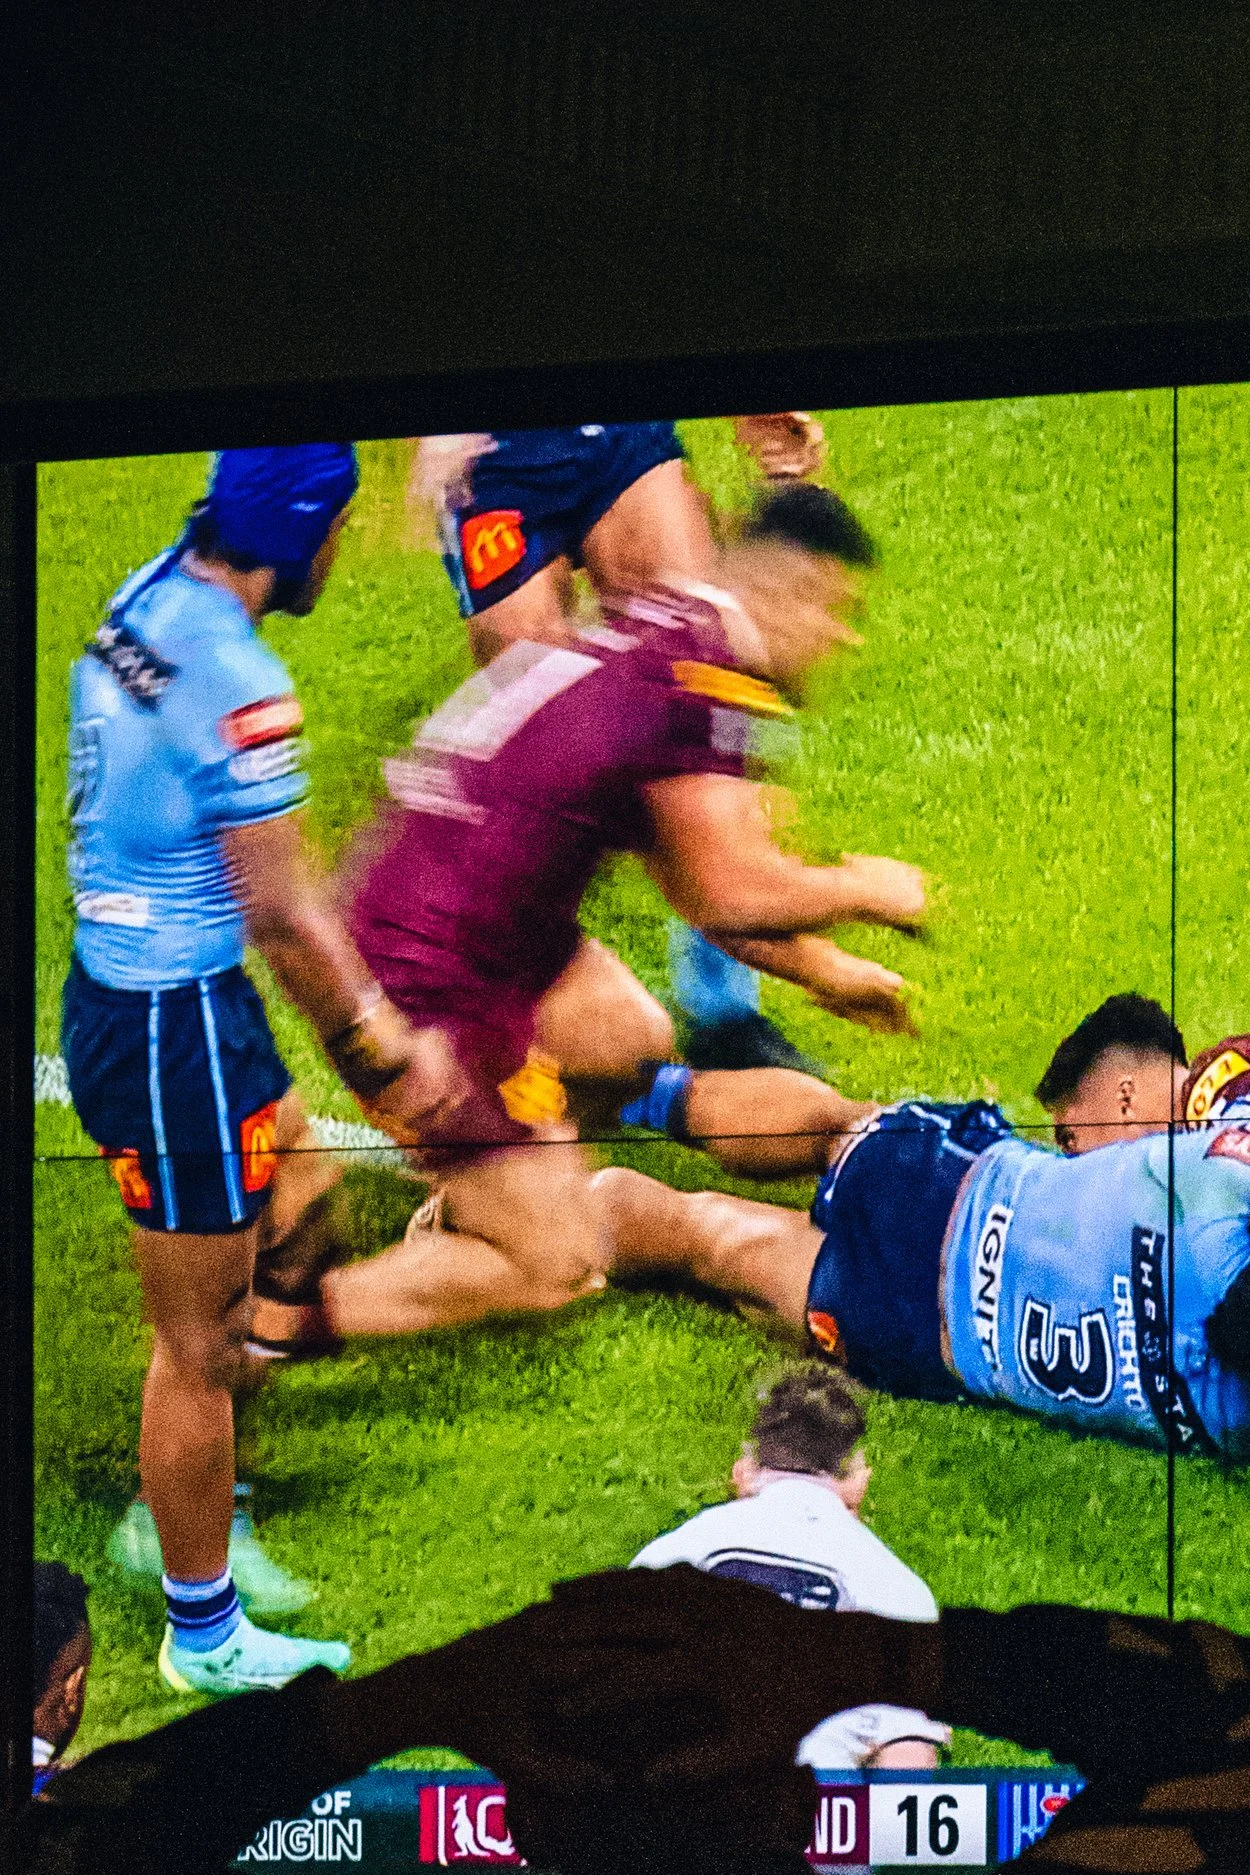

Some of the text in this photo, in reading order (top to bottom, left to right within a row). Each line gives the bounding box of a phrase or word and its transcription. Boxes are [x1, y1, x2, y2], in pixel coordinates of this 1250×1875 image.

[976, 1212, 1008, 1370] IGNIT
[1140, 1231, 1157, 1322] THE
[1018, 1294, 1114, 1406] 3
[311, 1790, 351, 1816] OF
[804, 1796, 857, 1855] ND
[897, 1793, 960, 1857] 16
